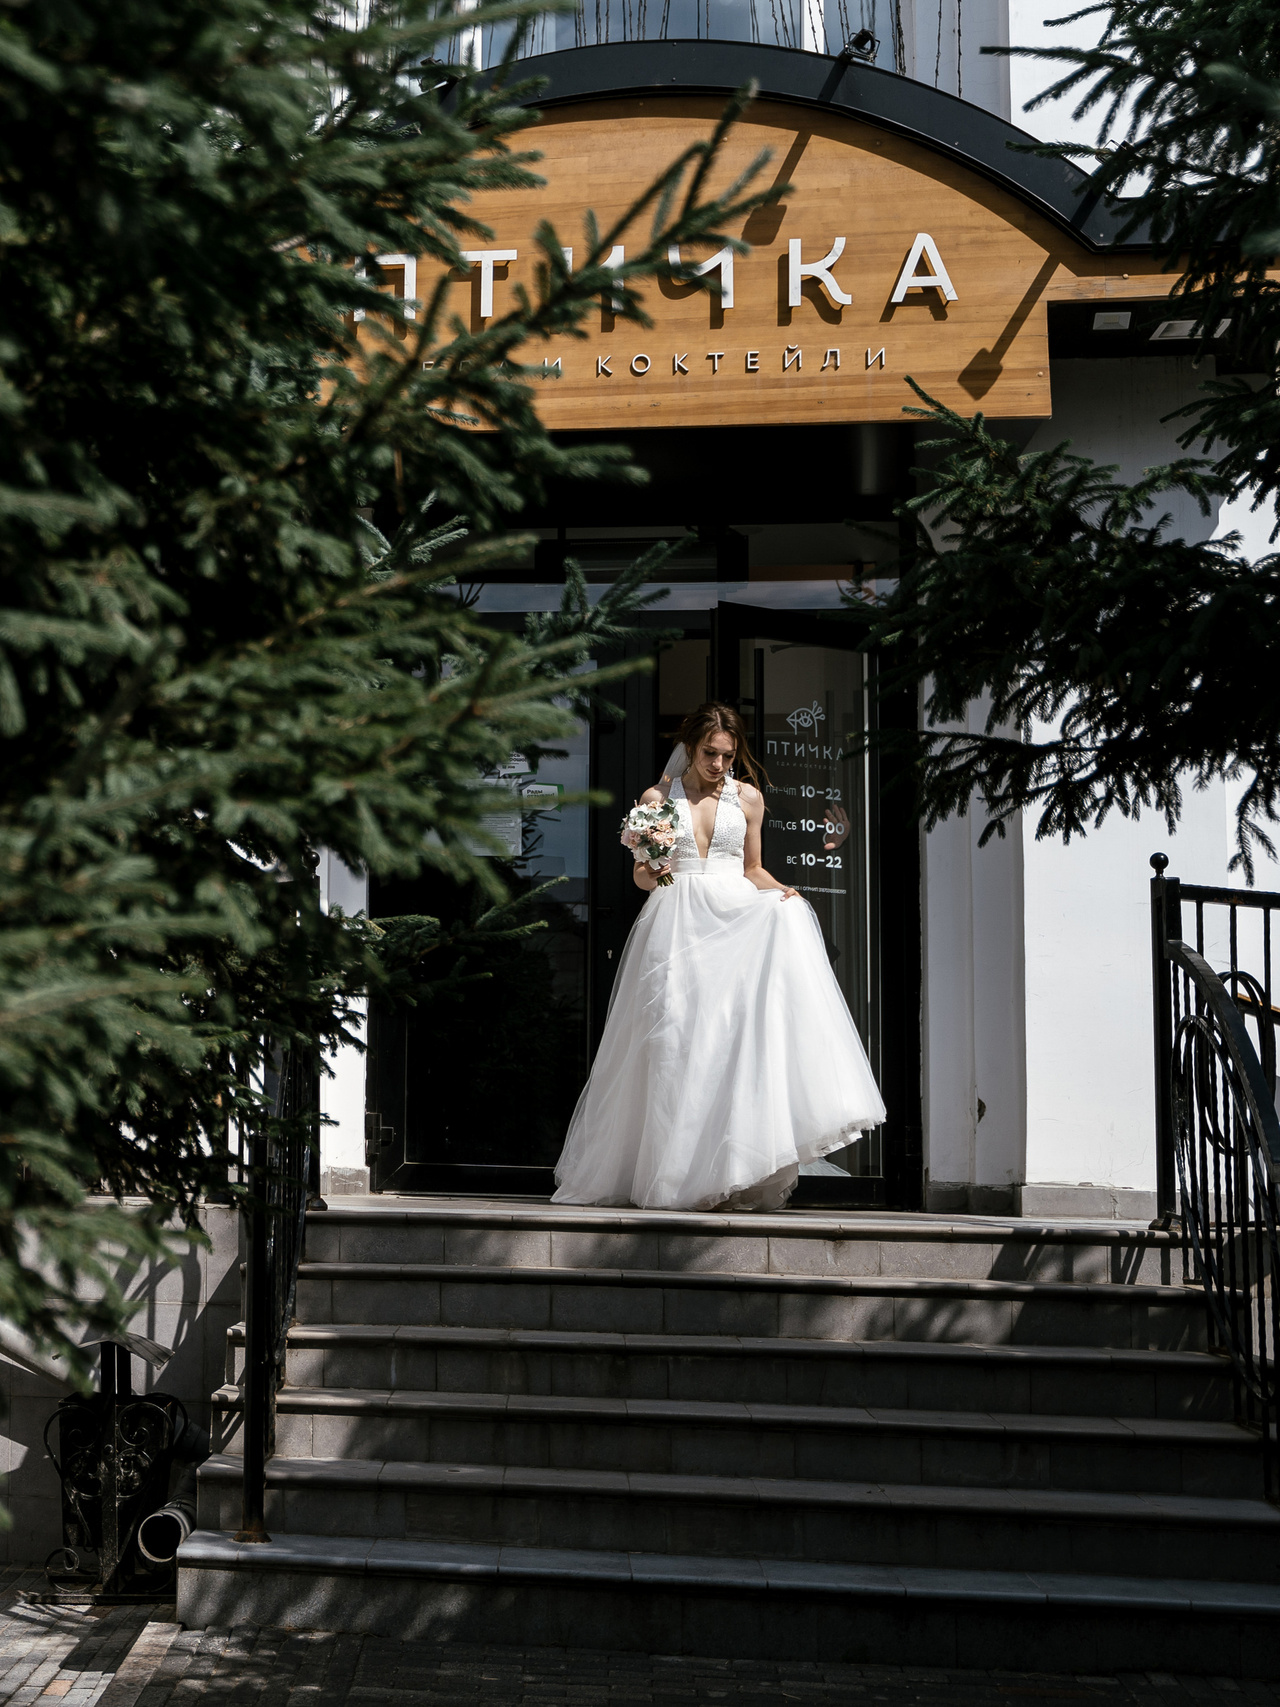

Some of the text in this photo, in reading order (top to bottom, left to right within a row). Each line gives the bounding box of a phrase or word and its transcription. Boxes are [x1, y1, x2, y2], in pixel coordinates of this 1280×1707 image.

[597, 345, 885, 373] КОКТЕЙЛИ
[767, 740, 844, 760] ПТИЧКА
[800, 785, 841, 800] 10-22
[800, 819, 844, 835] 10-00
[786, 853, 842, 869] ВС 10-22
